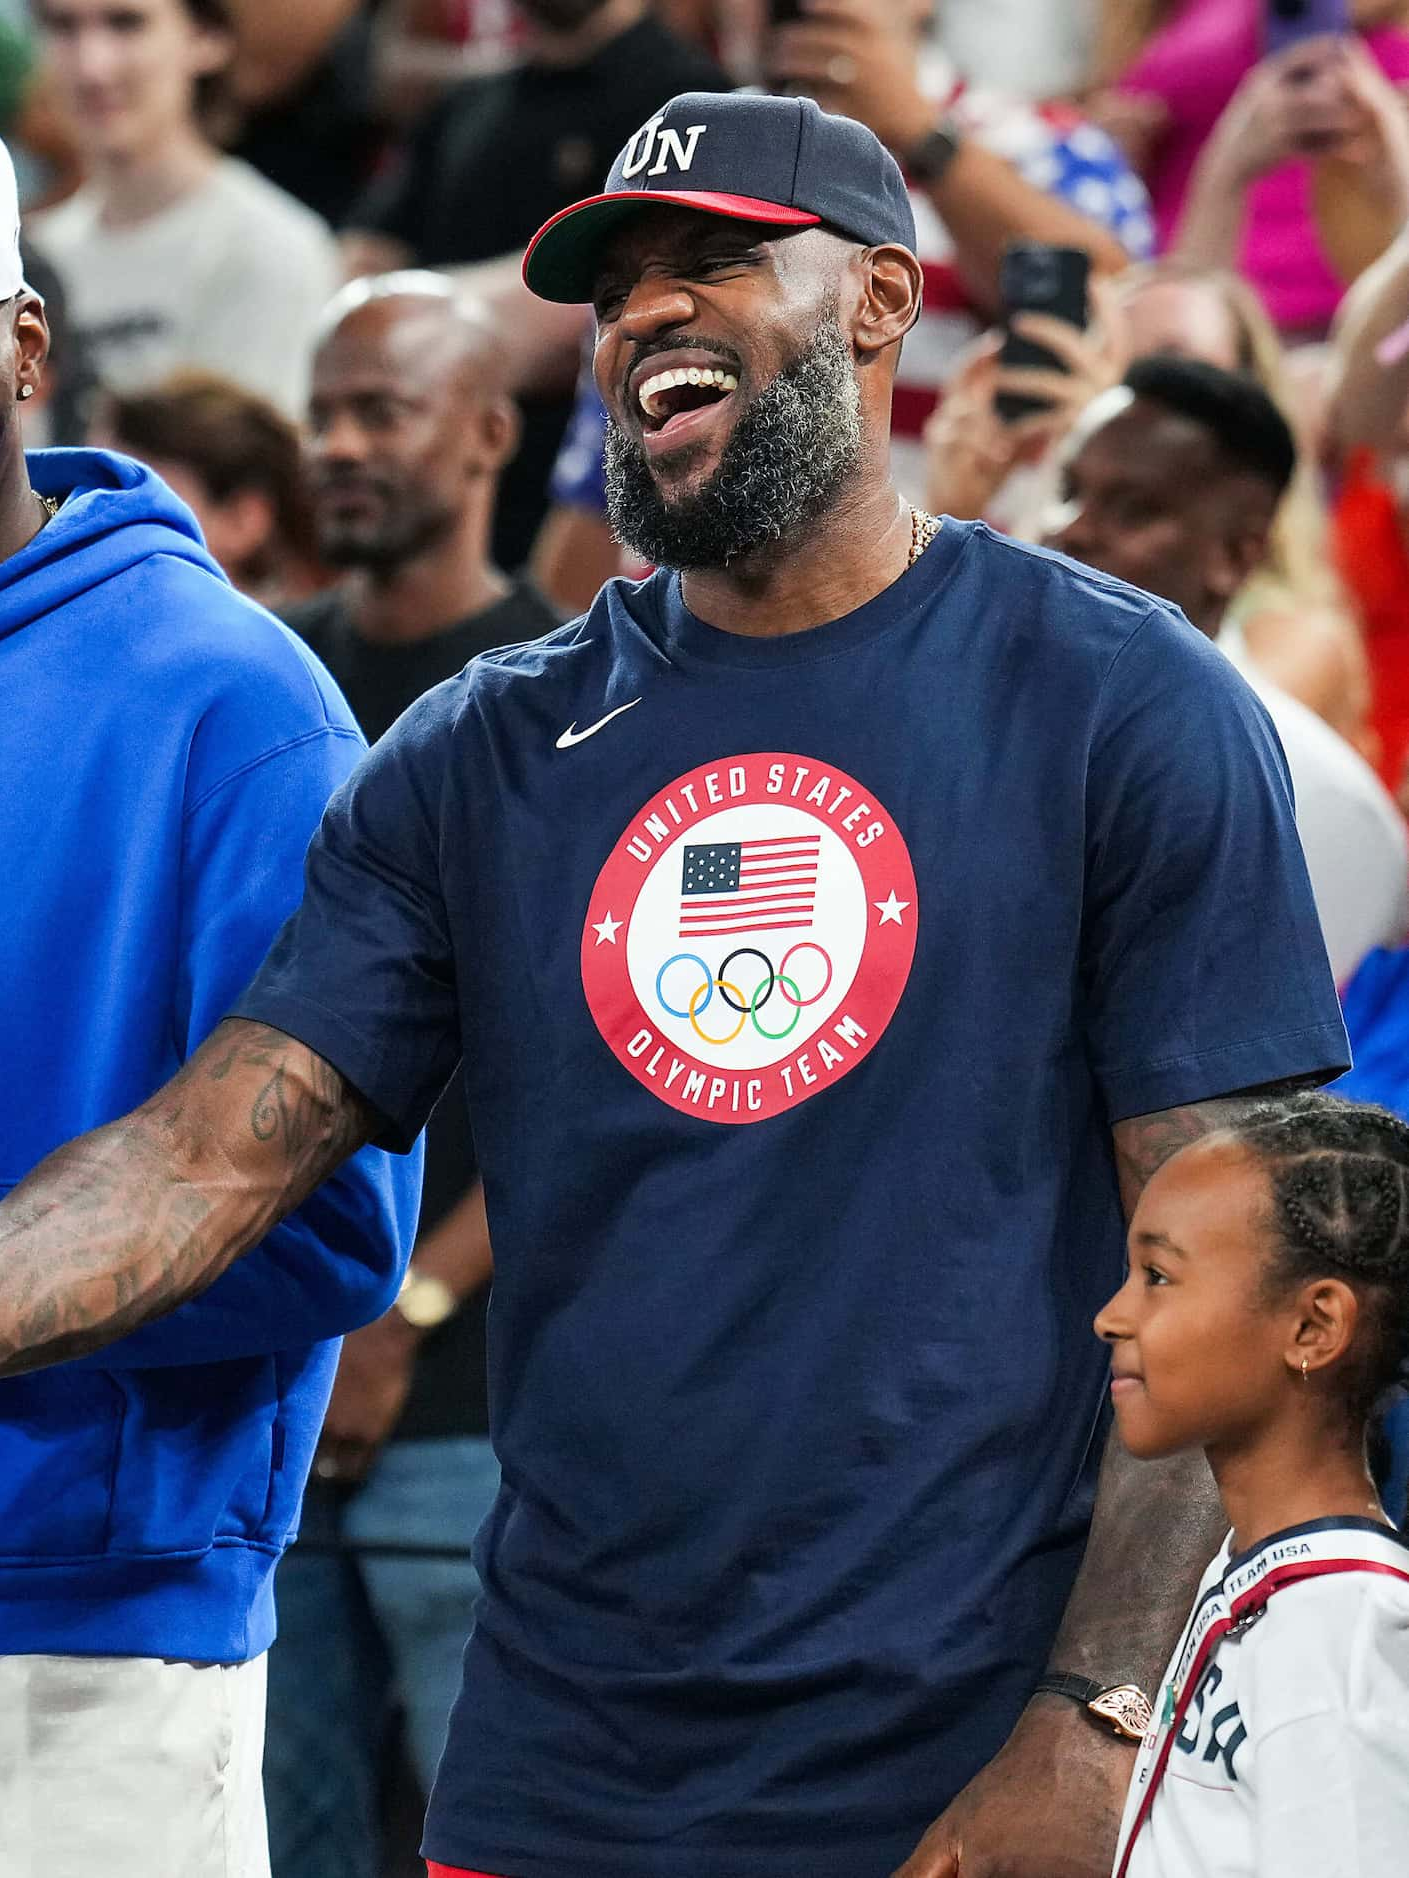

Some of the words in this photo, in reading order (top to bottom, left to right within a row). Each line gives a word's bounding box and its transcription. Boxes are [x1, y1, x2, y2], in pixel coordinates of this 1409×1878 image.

[622, 116, 707, 180] UN
[625, 766, 747, 864] UNITED
[766, 764, 885, 848] STATES
[626, 1028, 762, 1112] OLYMPIC
[780, 1014, 868, 1097] TEAM
[1228, 1557, 1268, 1594] TEAM
[1272, 1543, 1312, 1562] USA
[1196, 1603, 1223, 1636] USA
